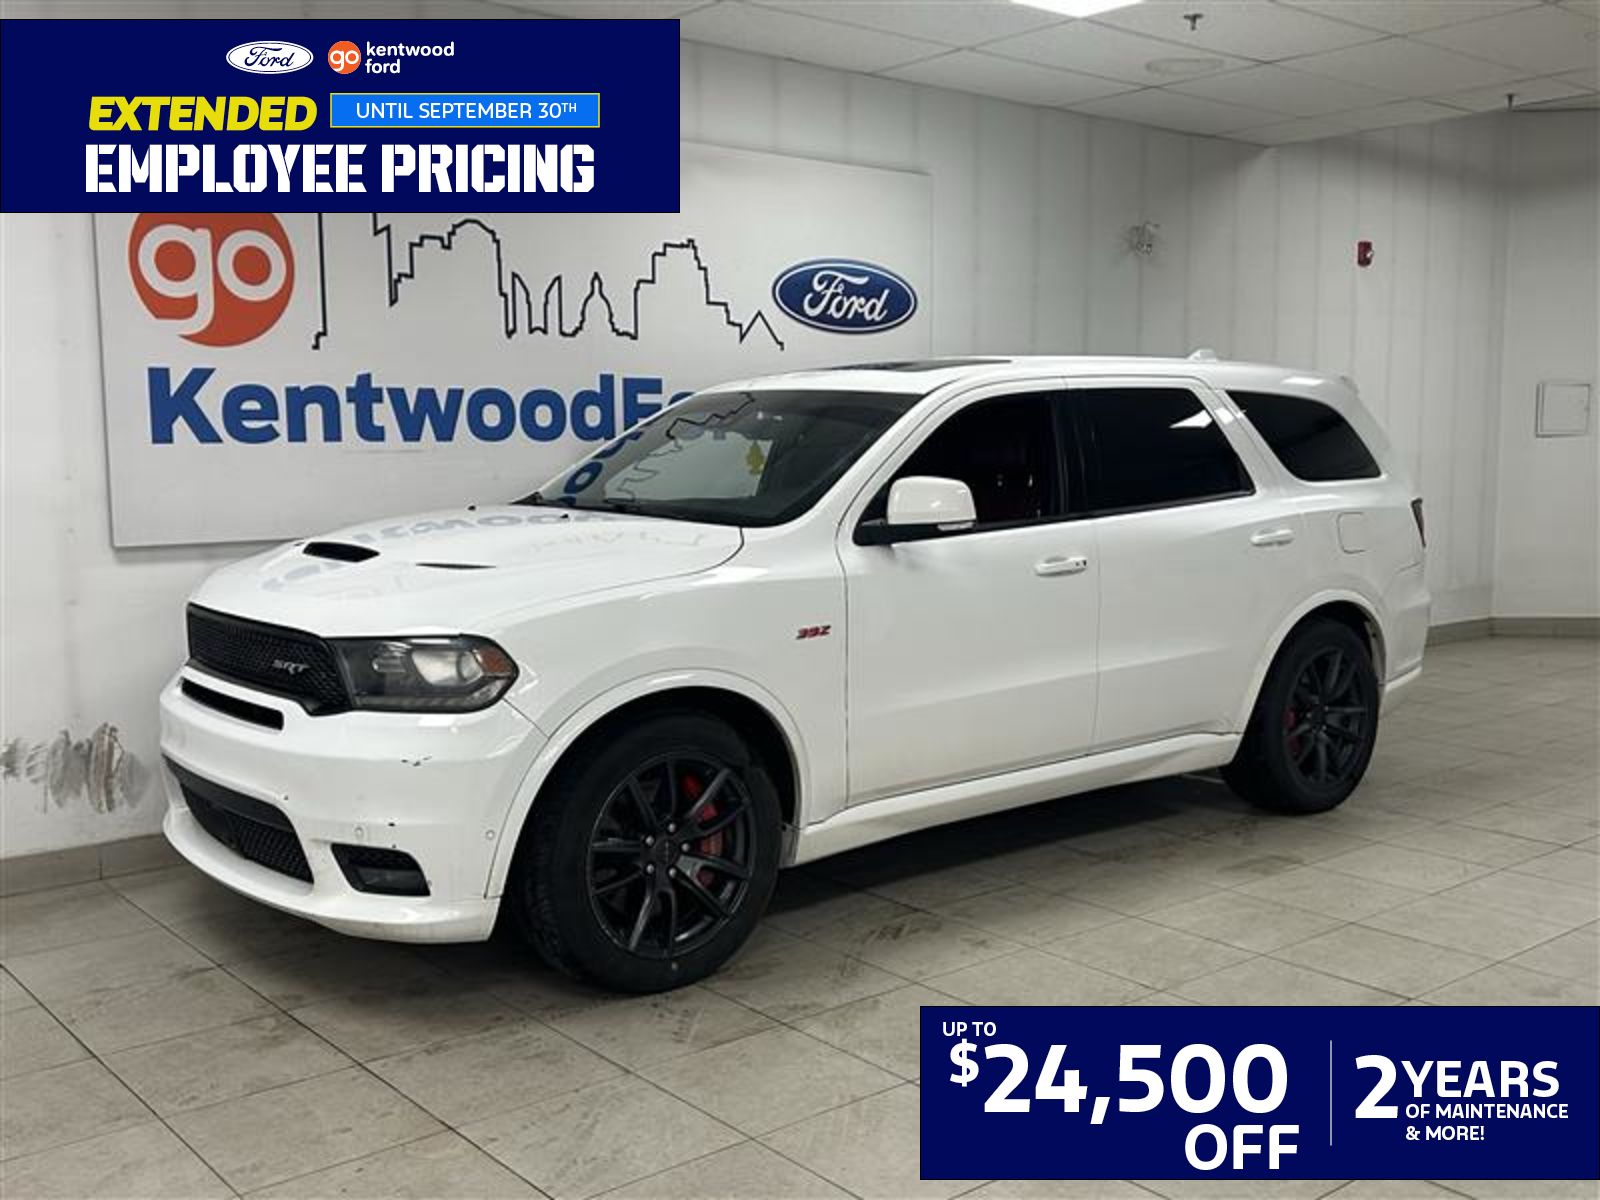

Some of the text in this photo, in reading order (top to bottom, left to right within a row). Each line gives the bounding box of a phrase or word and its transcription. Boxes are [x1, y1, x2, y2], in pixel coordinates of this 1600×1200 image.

[137, 223, 287, 336] go
[803, 270, 890, 322] Ford
[147, 366, 695, 446] KentwoodF
[796, 624, 832, 640] 392
[272, 659, 310, 675] SRT
